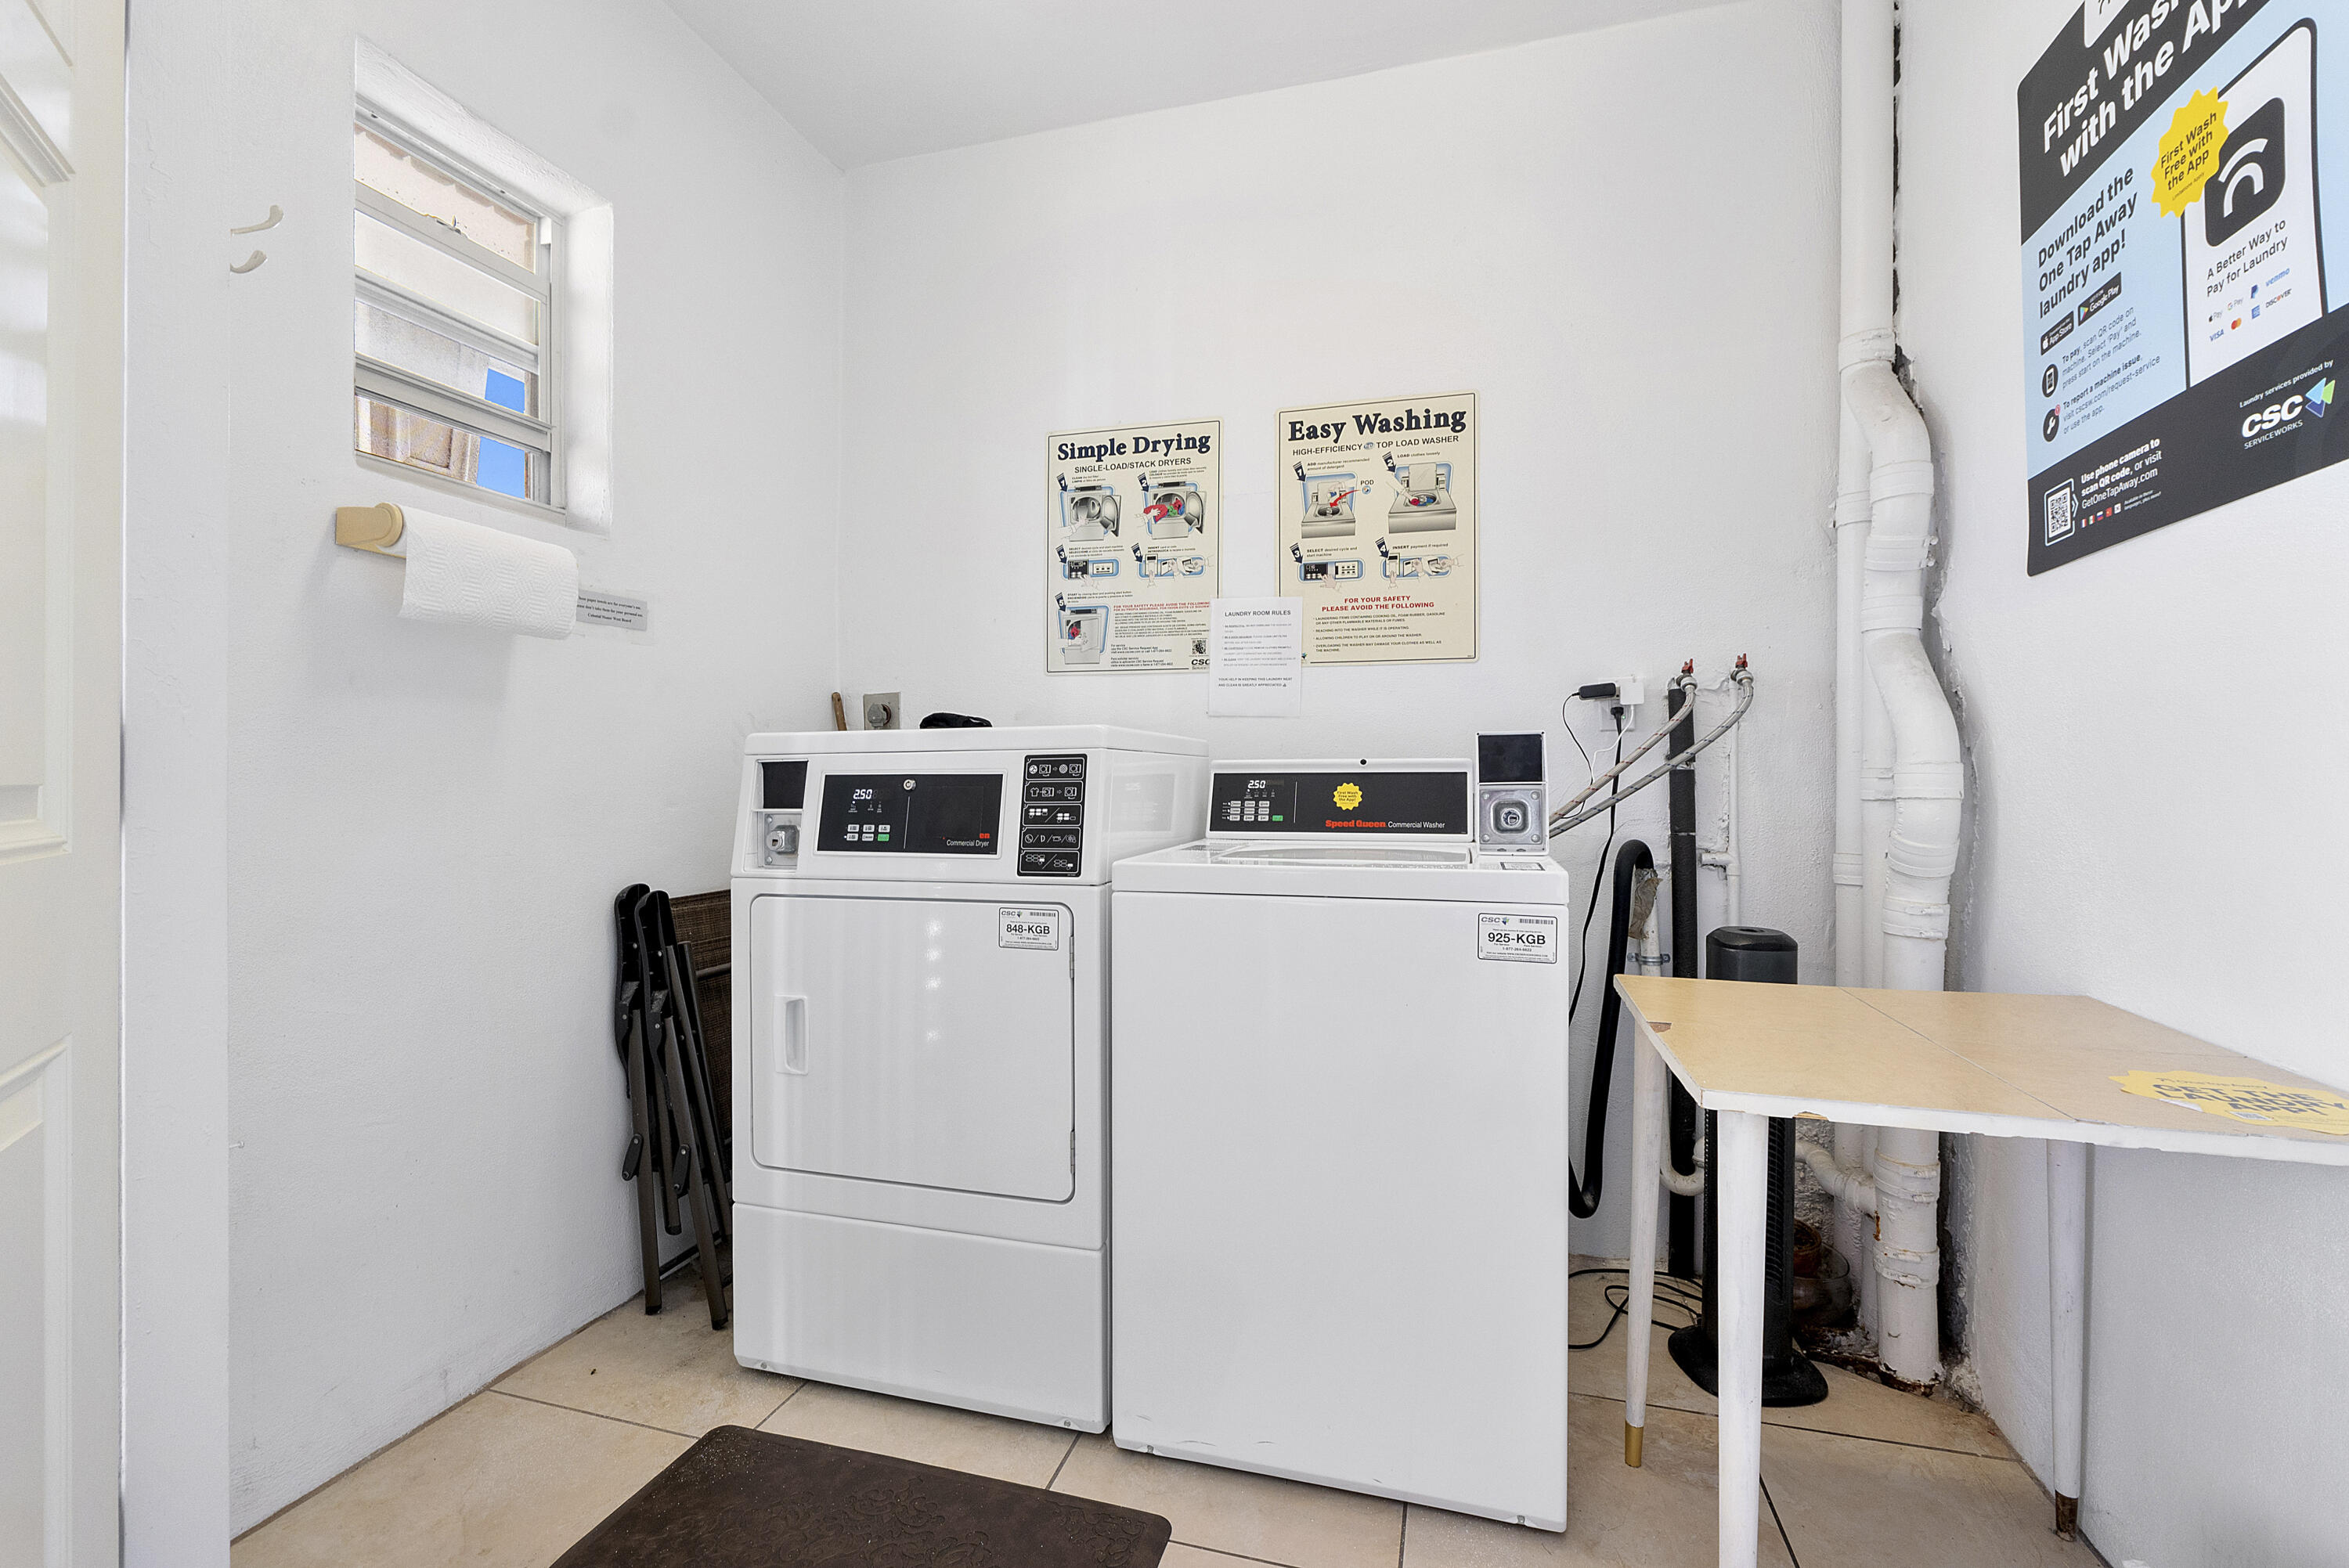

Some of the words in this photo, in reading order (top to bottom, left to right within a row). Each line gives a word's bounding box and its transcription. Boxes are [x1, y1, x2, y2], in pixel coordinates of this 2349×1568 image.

[2044, 67, 2099, 153] First
[2060, 100, 2116, 177] with
[2122, 41, 2174, 110] the
[2161, 141, 2183, 168] First
[2186, 112, 2217, 144] Wash
[2164, 155, 2186, 179] Free
[2188, 131, 2213, 157] with
[2168, 171, 2185, 191] the
[2187, 150, 2210, 175] App
[2038, 189, 2104, 269] Download
[2108, 168, 2134, 201] the
[2040, 261, 2064, 291] One
[2066, 236, 2091, 266] Tap
[2095, 192, 2138, 243] Away
[2207, 268, 2214, 280] A
[2216, 247, 2246, 273] Better
[2249, 229, 2272, 251] Way
[2275, 220, 2286, 233] to
[2040, 264, 2089, 319] laundry
[2093, 229, 2125, 271] app!
[2207, 279, 2225, 297] Pay
[2226, 268, 2242, 284] for
[2243, 236, 2288, 273] Laundry
[2265, 268, 2291, 287] venmo
[2090, 294, 2108, 312] Google
[2107, 285, 2120, 298] Play
[2265, 288, 2293, 308] DISCOVER
[2049, 333, 2059, 345] App
[2059, 323, 2073, 337] Store
[2062, 355, 2087, 376] machine.
[2087, 340, 2106, 358] Select
[2123, 317, 2137, 333] and
[2083, 334, 2097, 349] scan
[2098, 325, 2107, 337] QR
[2109, 314, 2124, 330] code
[2125, 307, 2134, 317] on
[2209, 328, 2225, 341] VISA
[2062, 374, 2077, 391] press
[2078, 364, 2092, 380] start
[2092, 357, 2101, 366] on
[2101, 349, 2112, 362] the
[2113, 329, 2142, 353] machine.
[2070, 388, 2089, 405] report
[2094, 366, 2121, 389] machine
[2122, 354, 2143, 372] issue,
[2239, 392, 2264, 408] Laundry
[2264, 379, 2292, 396] services
[2292, 363, 2323, 384] provided
[2324, 359, 2334, 369] by
[1288, 420, 1347, 444] Easy
[1352, 408, 1467, 435] Washing
[2063, 409, 2074, 422] visit
[2063, 425, 2070, 434] or
[2070, 420, 2080, 431] use
[2081, 413, 2091, 426] the
[2091, 405, 2105, 419] app.
[2242, 395, 2304, 438] CSC
[2244, 420, 2304, 449] SERVICEWORKS
[1057, 438, 1127, 462] Simple
[1132, 433, 1211, 457] Drying
[1293, 443, 1363, 456] HIGH-EFFICIENCY
[1395, 438, 1420, 447] LOAD
[1421, 435, 1460, 445] WASHER
[2080, 471, 2095, 484] Use
[2095, 459, 2119, 479] phone
[2119, 443, 2150, 464] camera
[2150, 438, 2160, 449] to
[1074, 460, 1156, 474] SINGLE-LOAD/STACK
[1158, 457, 1192, 467] DRYERS
[2081, 482, 2099, 496] scan
[2099, 474, 2111, 488] QR
[2111, 467, 2133, 483] code,
[2134, 460, 2144, 471] or
[2145, 450, 2163, 466] visit
[2081, 467, 2159, 509] GetOneTapAway.com
[853, 788, 873, 799] 2.50
[1325, 820, 1355, 828] Speed
[975, 839, 990, 848] Dryer
[1006, 924, 1050, 935] 848-KGB
[1488, 932, 1546, 945] 925-KGB
[2152, 1084, 2227, 1095] GET
[2232, 1089, 2322, 1101] THE
[2155, 1090, 2348, 1110] LAUNDRY
